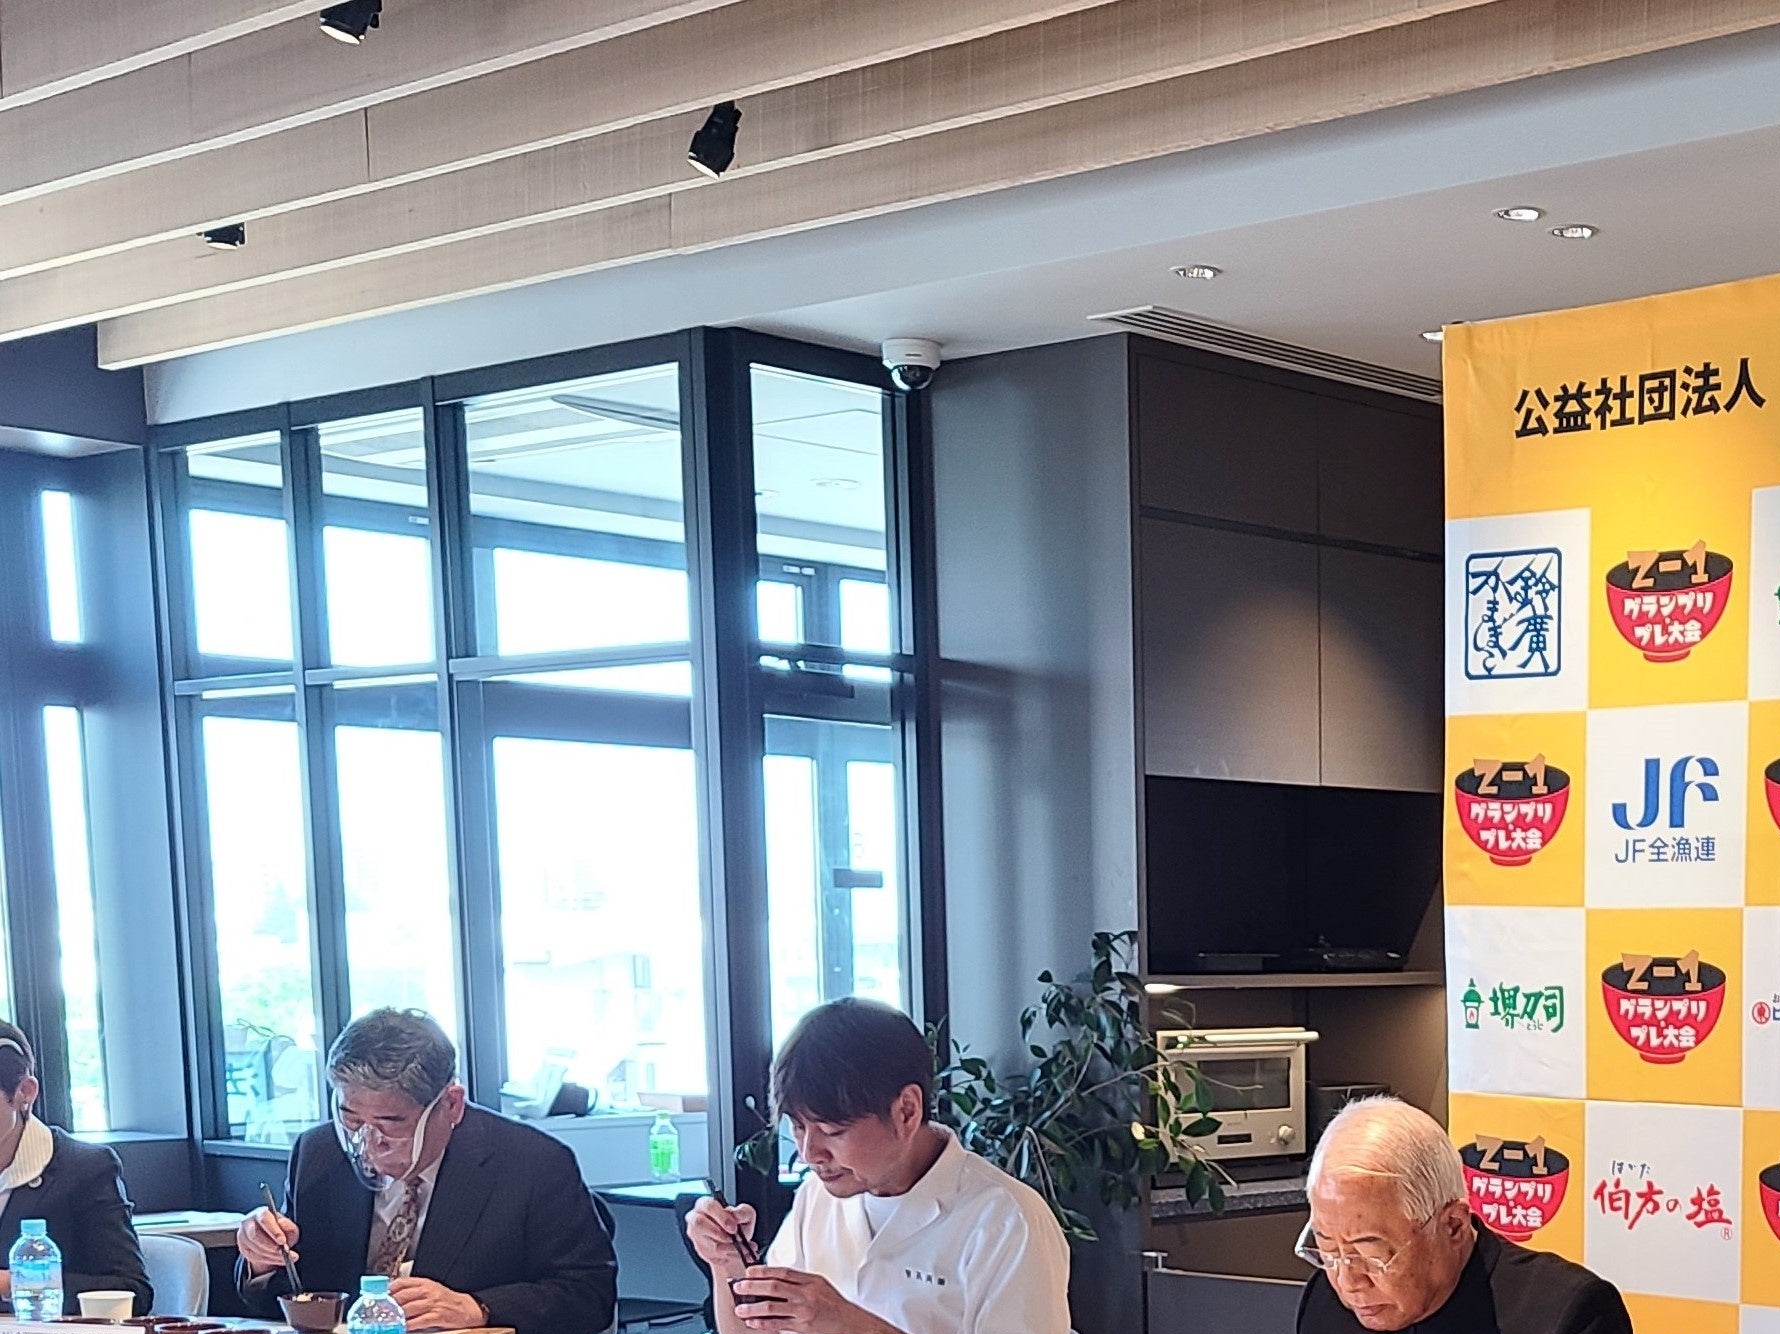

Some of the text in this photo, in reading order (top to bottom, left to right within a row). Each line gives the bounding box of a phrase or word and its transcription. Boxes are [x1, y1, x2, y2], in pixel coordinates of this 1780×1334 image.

[1514, 357, 1766, 438] 公益社団法人
[1623, 591, 1713, 619] グランプリ
[1635, 620, 1702, 645] プレ大会
[1470, 801, 1552, 826] グランプリ
[1480, 828, 1542, 851] プレ大会
[1614, 837, 1716, 864] JF全漁連
[1489, 981, 1564, 1034] 堺刀司
[1617, 998, 1707, 1022] グランプリ
[1629, 1024, 1697, 1048] プレ大会
[1472, 1176, 1552, 1202] グランプリ
[1481, 1203, 1542, 1227] プレ大会
[1593, 1177, 1733, 1230] 伯方の塩
